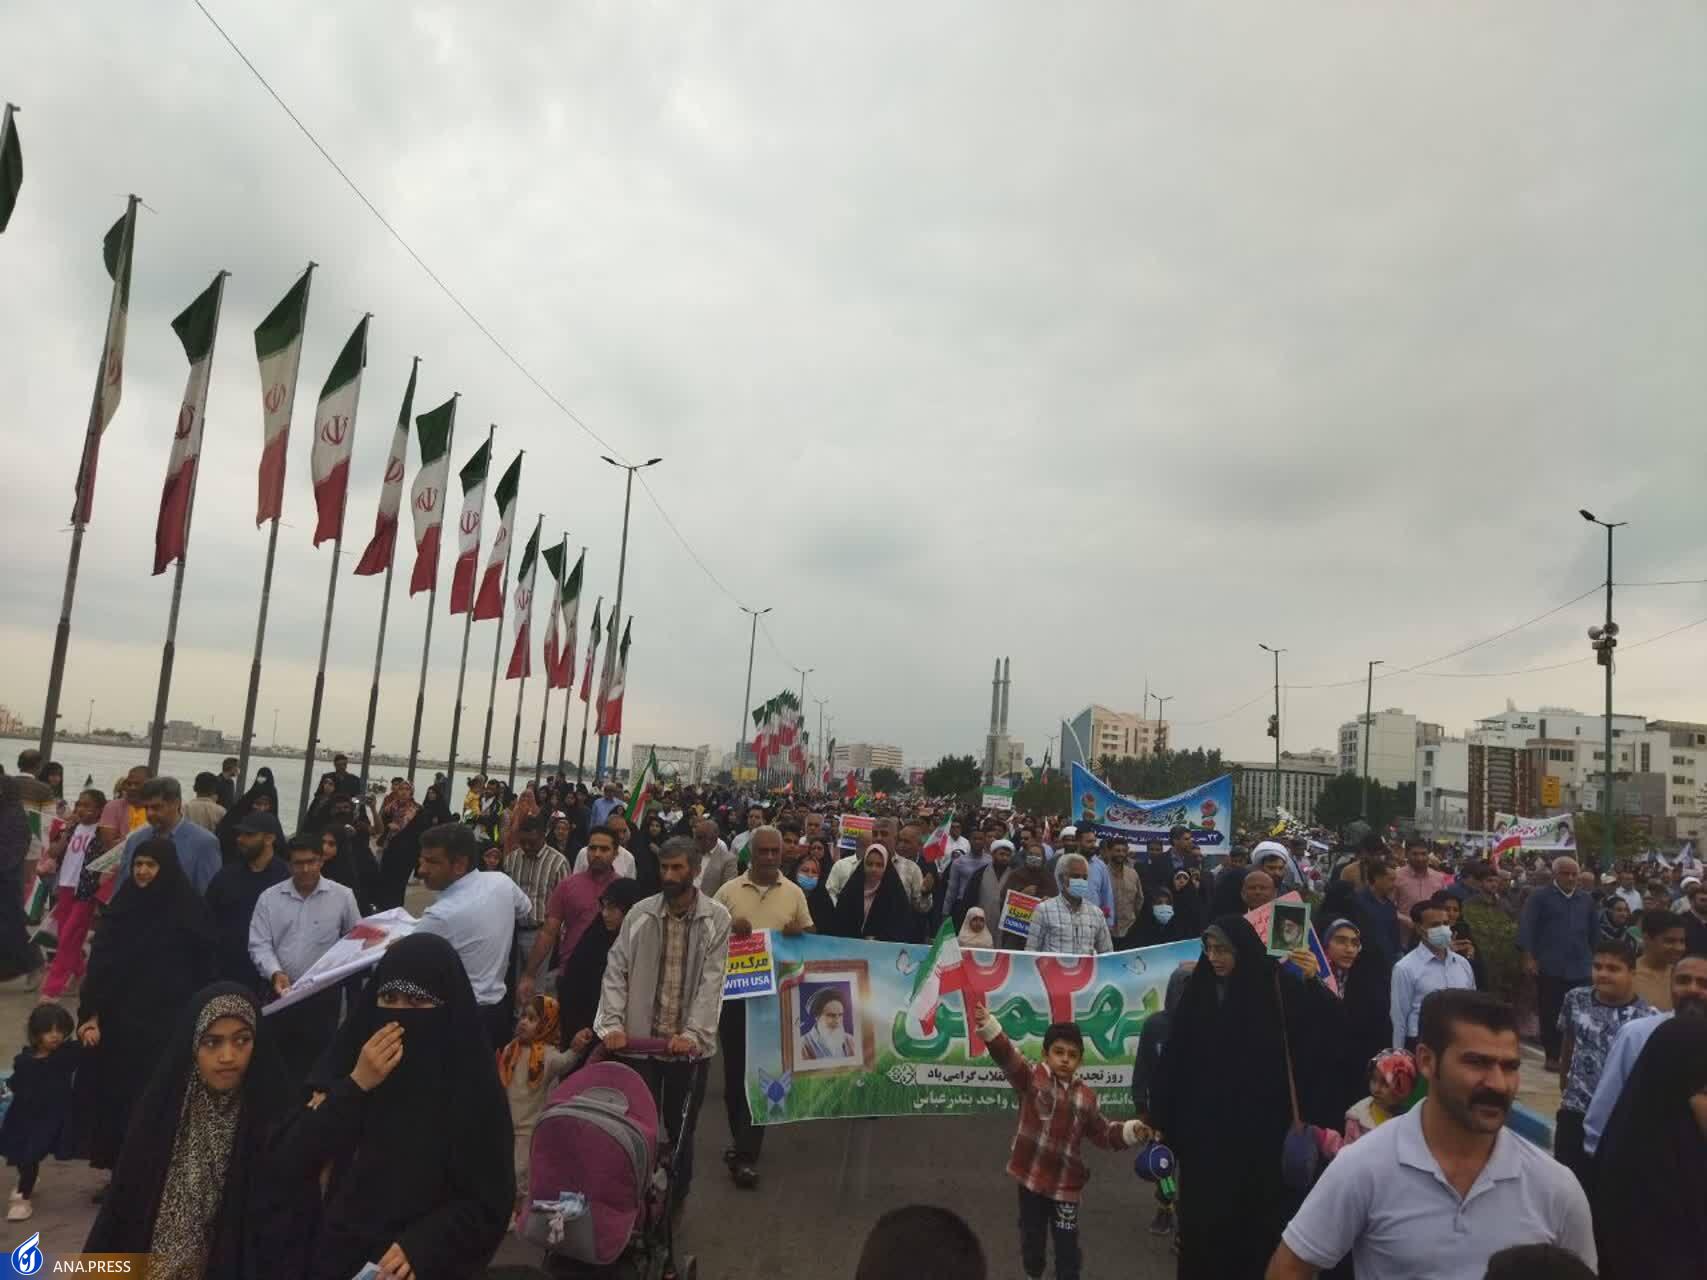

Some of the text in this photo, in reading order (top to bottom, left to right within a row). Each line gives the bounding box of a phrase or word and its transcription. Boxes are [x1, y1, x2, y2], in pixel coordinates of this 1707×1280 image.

[740, 956, 768, 969] مرگ
[751, 975, 770, 986] USA
[928, 1067, 942, 1080] باد
[943, 1071, 977, 1083] گرامی
[977, 1071, 1006, 1081] نقلاب
[1106, 1072, 1124, 1084] روز
[977, 1093, 1008, 1109] واحد
